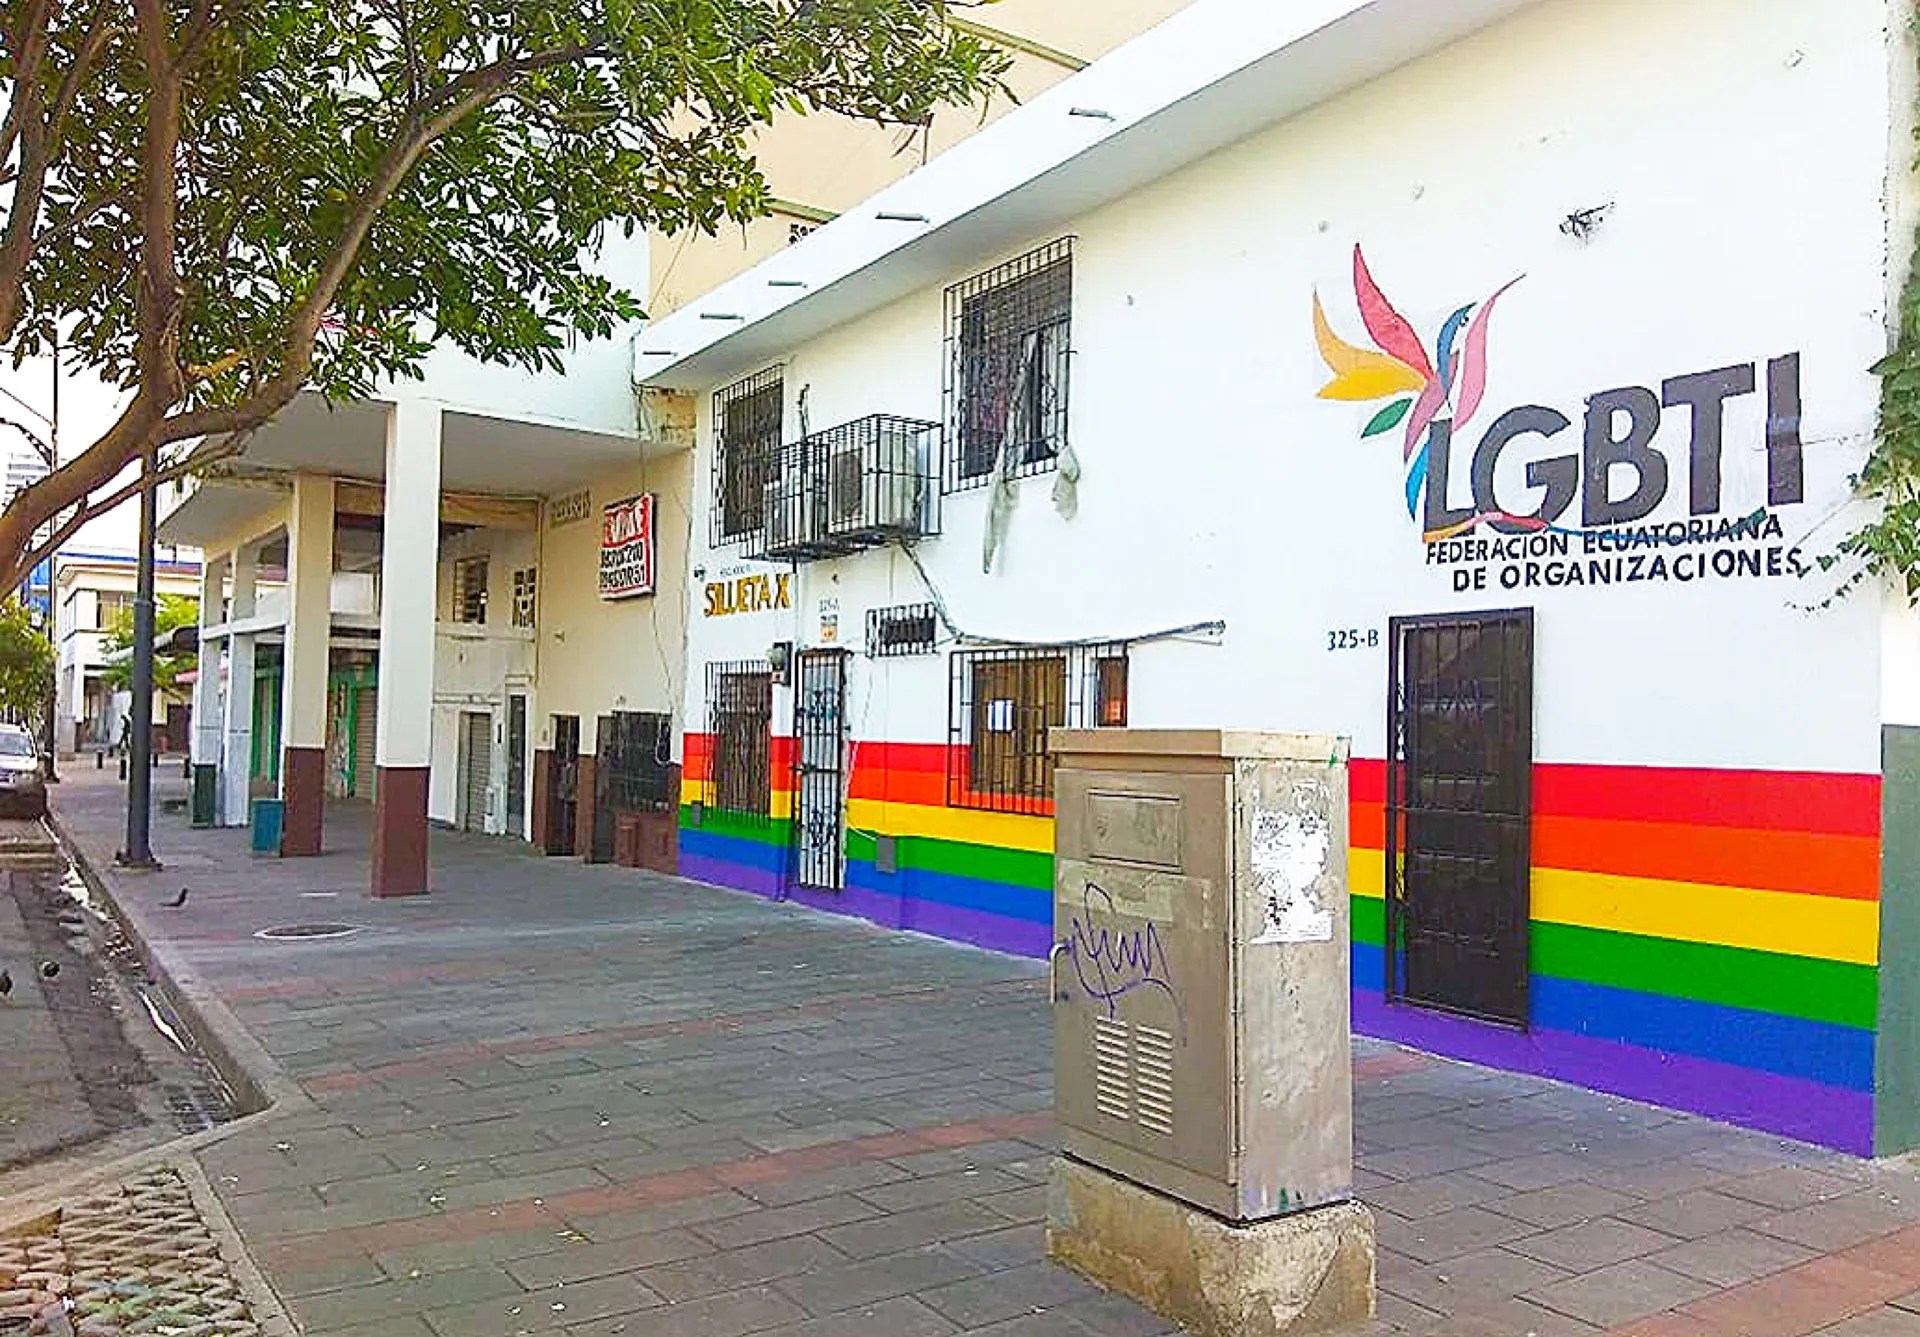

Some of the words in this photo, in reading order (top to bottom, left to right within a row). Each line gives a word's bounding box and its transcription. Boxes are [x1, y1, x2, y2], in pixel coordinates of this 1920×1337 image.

[1424, 352, 1803, 541] LGBTI
[1583, 513, 1783, 554] ECUATORIANA
[1453, 567, 1486, 592] DE
[1500, 546, 1802, 588] ORGANIZACIONES
[774, 573, 790, 609] X
[1327, 628, 1378, 651] 325-B
